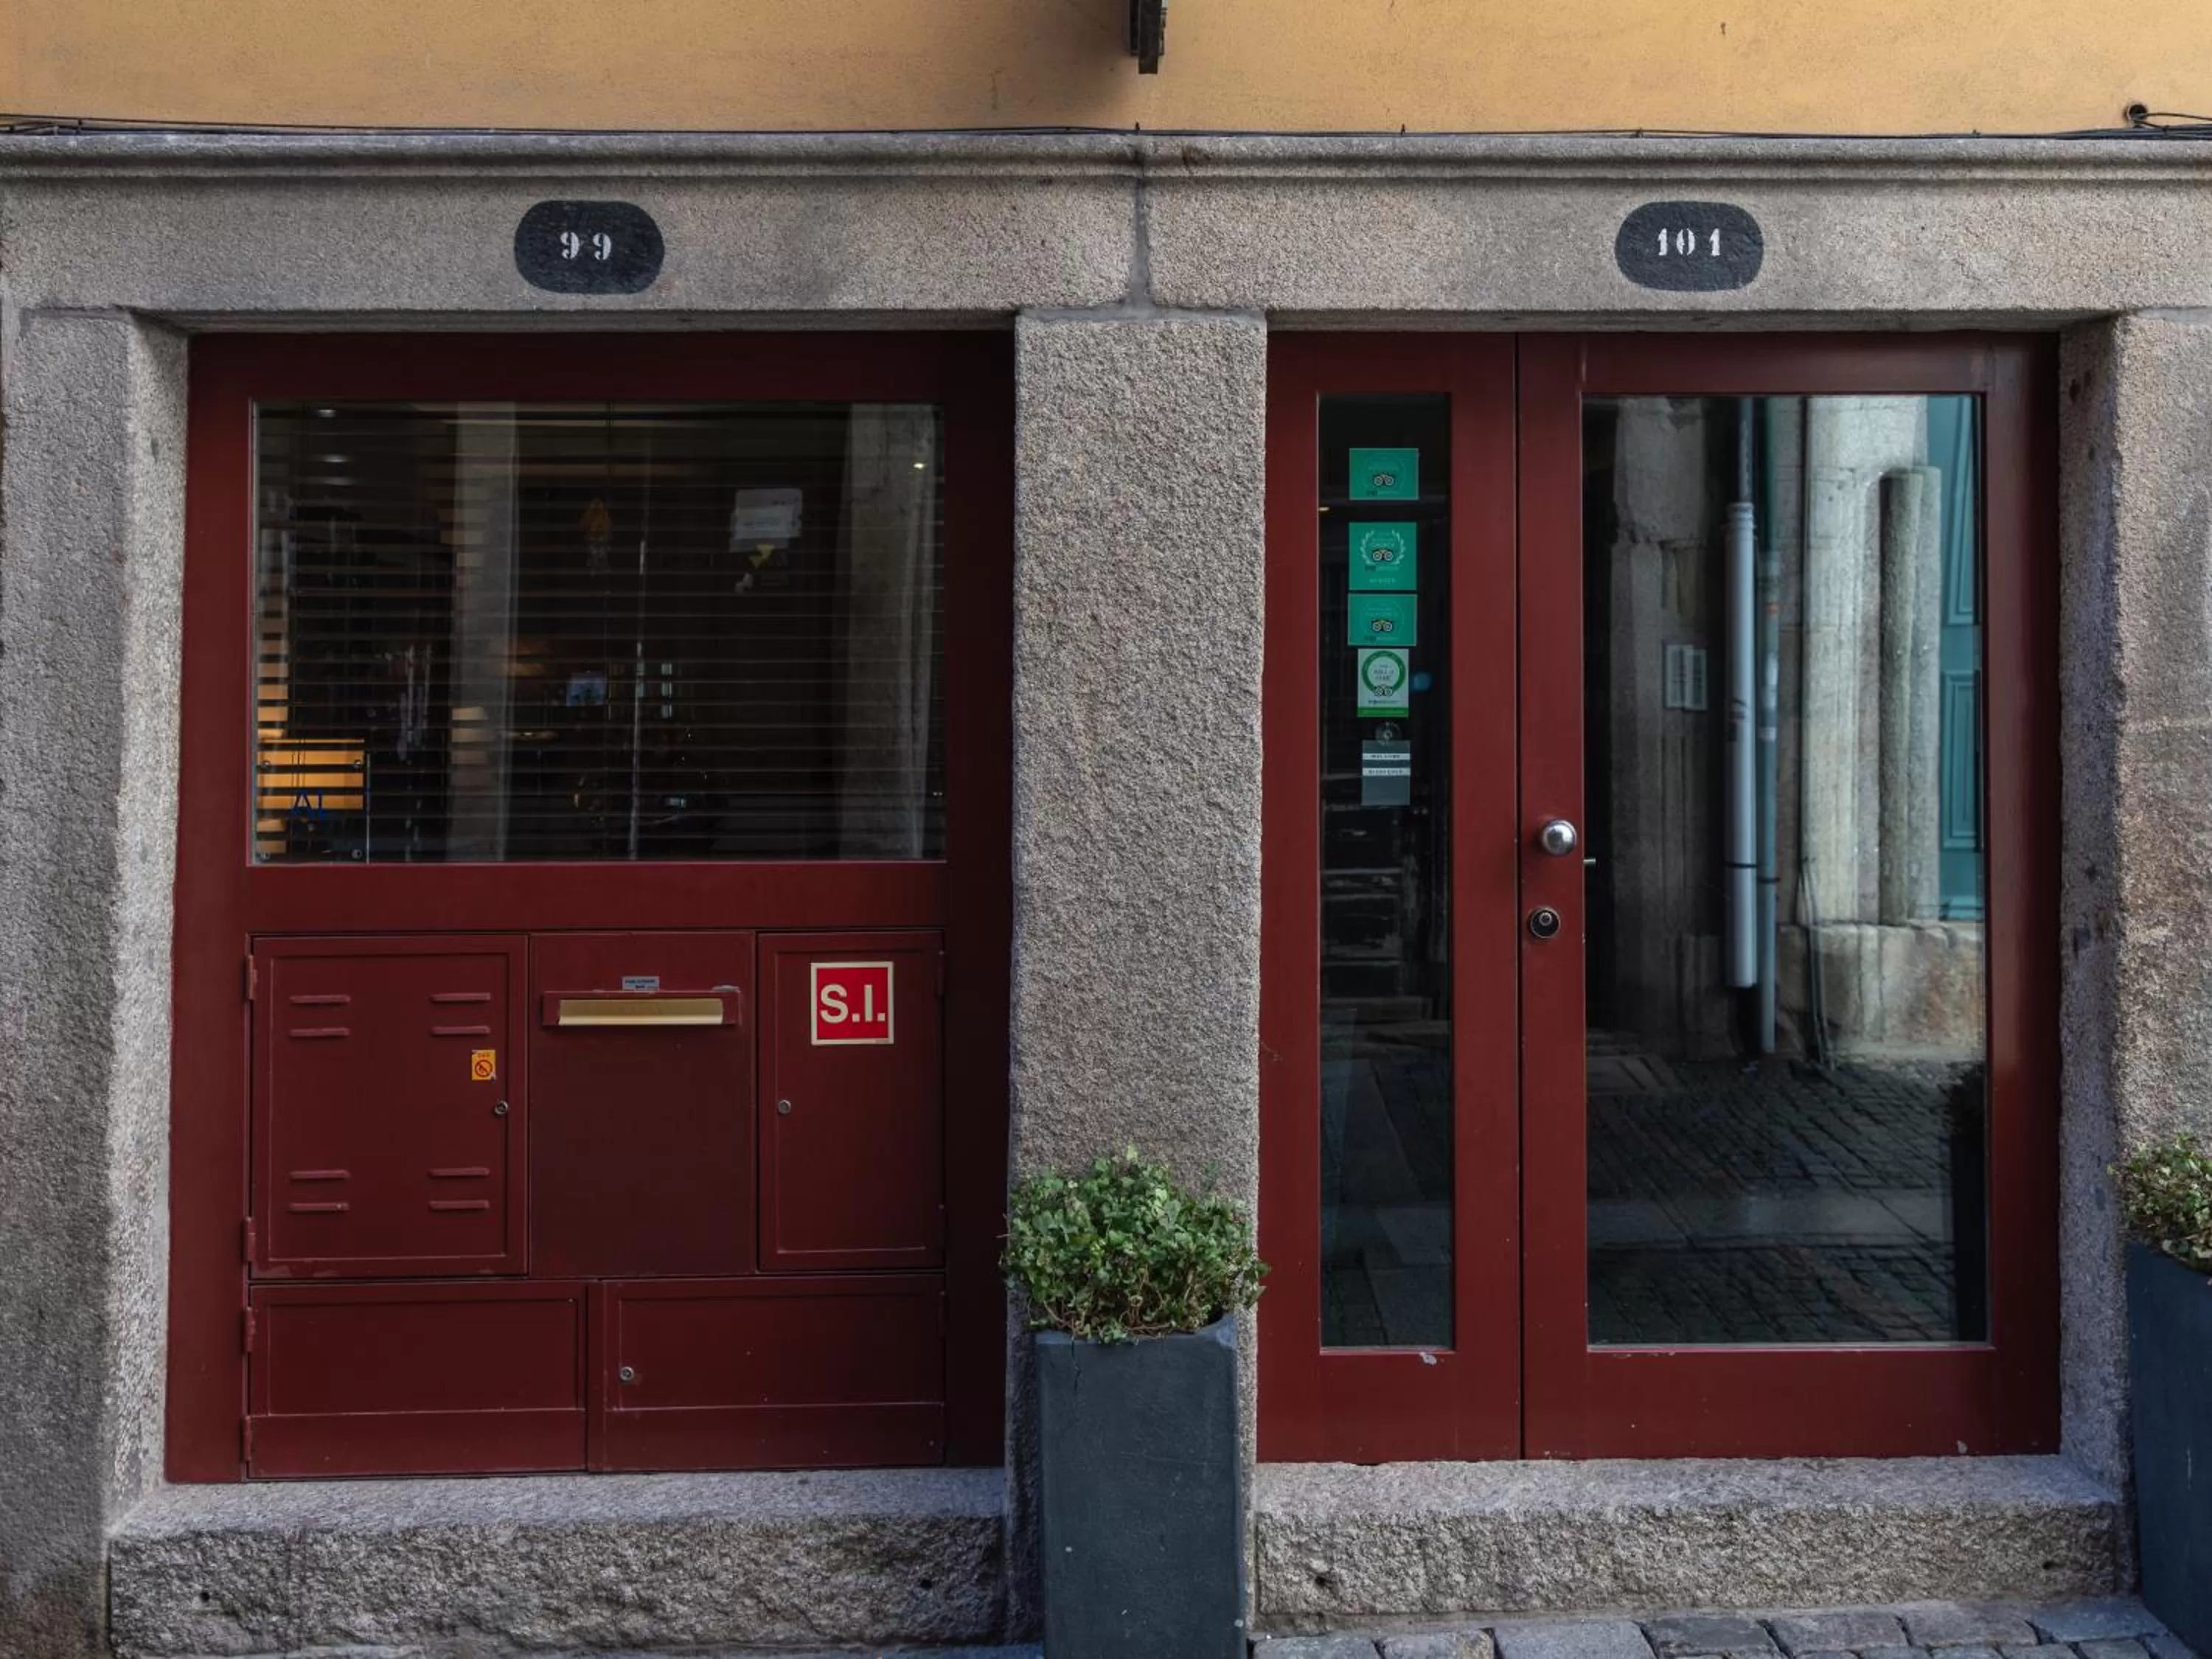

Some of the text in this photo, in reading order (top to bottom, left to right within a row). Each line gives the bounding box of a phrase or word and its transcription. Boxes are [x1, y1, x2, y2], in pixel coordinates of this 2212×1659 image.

[560, 232, 612, 260] 99
[1657, 228, 1721, 257] 101
[819, 983, 886, 1024] S.I.
